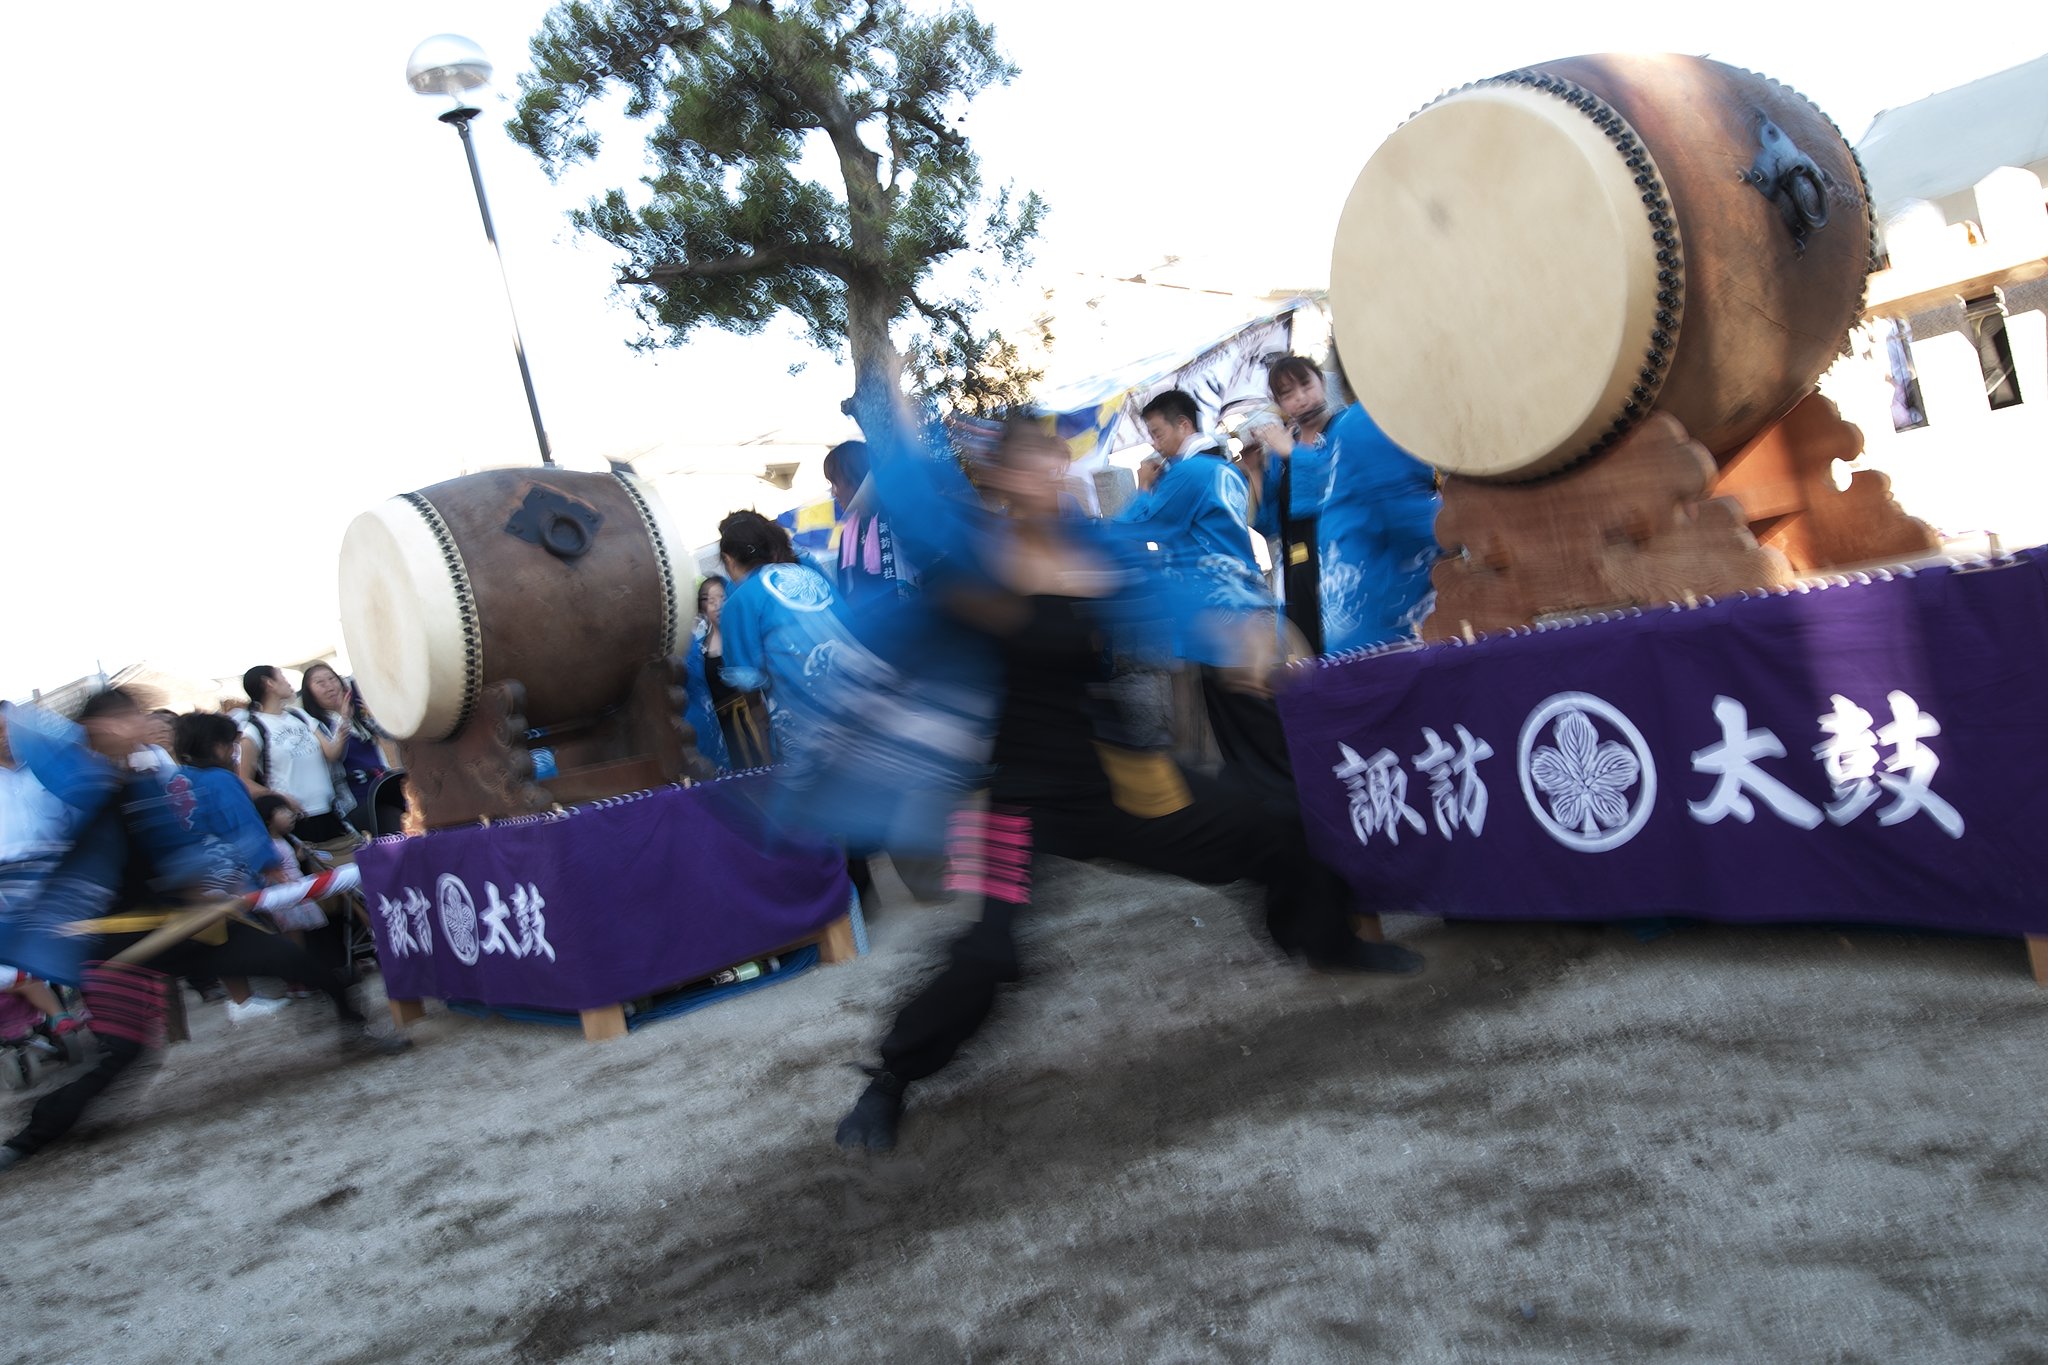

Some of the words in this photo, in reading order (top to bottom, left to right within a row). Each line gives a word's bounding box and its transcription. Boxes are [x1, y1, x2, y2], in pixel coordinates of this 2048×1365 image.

[1333, 724, 1494, 846] 諏訪
[1688, 689, 1966, 839] 太鼓
[479, 880, 556, 963] 太鼓
